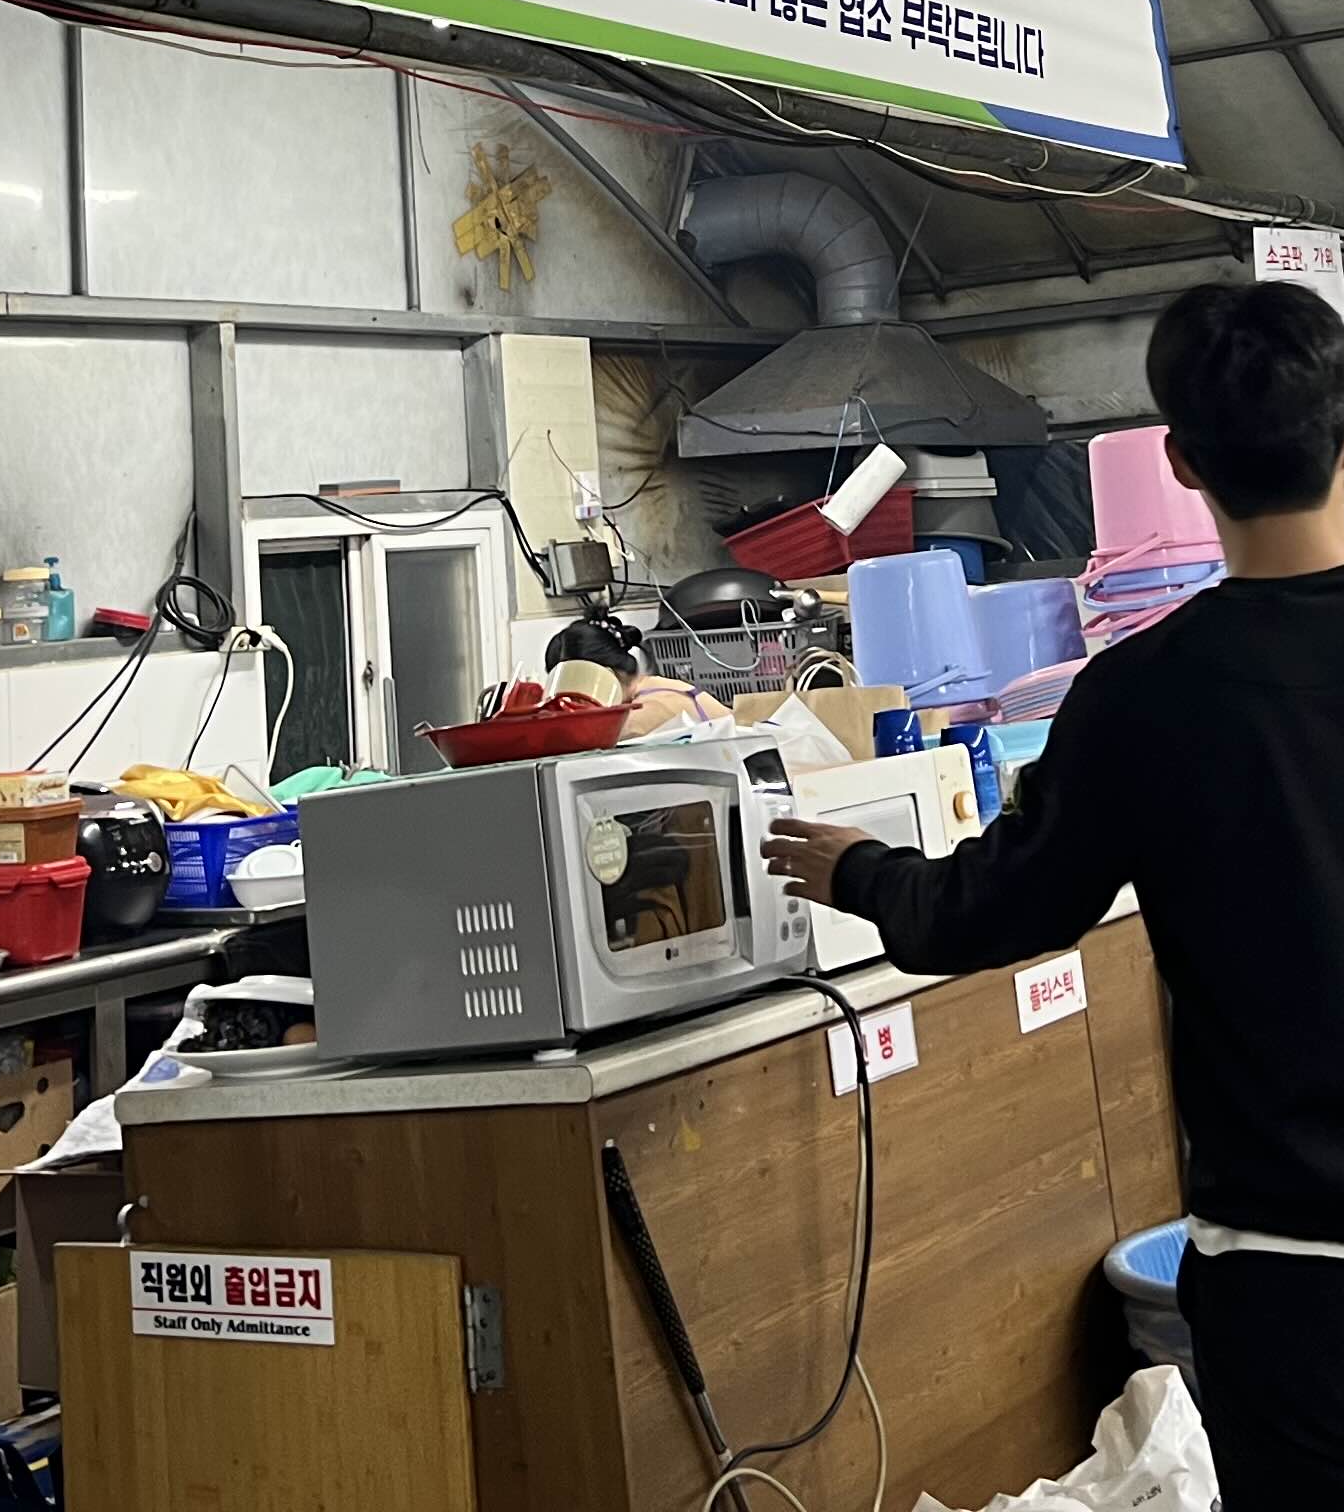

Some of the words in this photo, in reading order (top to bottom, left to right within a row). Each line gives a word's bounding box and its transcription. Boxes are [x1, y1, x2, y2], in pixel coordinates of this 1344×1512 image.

[1030, 969, 1075, 1012] 플라스틱
[141, 1262, 212, 1306] 직원외
[225, 1266, 321, 1310] 출입금지
[154, 1315, 188, 1329] Staff
[191, 1317, 222, 1335] Only
[227, 1319, 310, 1337] Admittance
